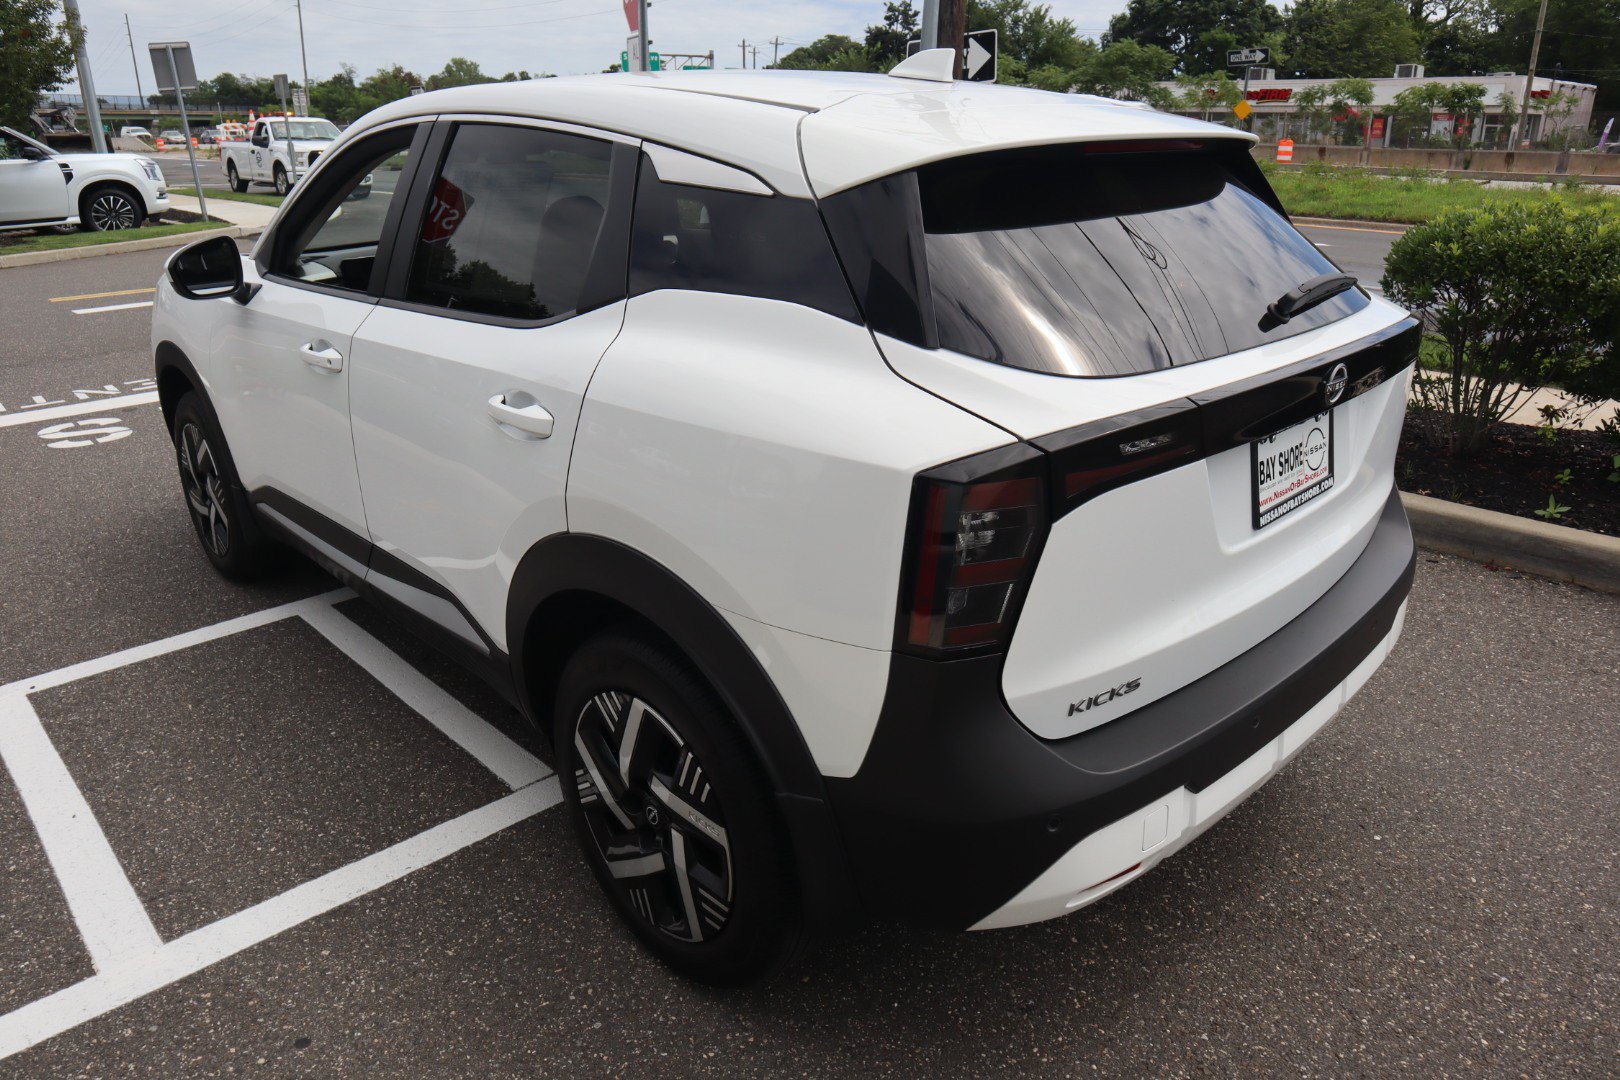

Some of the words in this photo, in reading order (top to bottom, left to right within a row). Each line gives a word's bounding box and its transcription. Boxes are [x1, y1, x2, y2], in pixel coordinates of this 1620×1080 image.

[1258, 88, 1293, 101] FIRM
[1259, 454, 1276, 485] BAY
[1278, 442, 1304, 477] SHORE
[1304, 441, 1327, 457] NISSAN
[1260, 476, 1334, 527] NISSANOFBAYSHORE.COM
[1067, 677, 1142, 717] KICKS
[688, 810, 721, 838] KICKS
